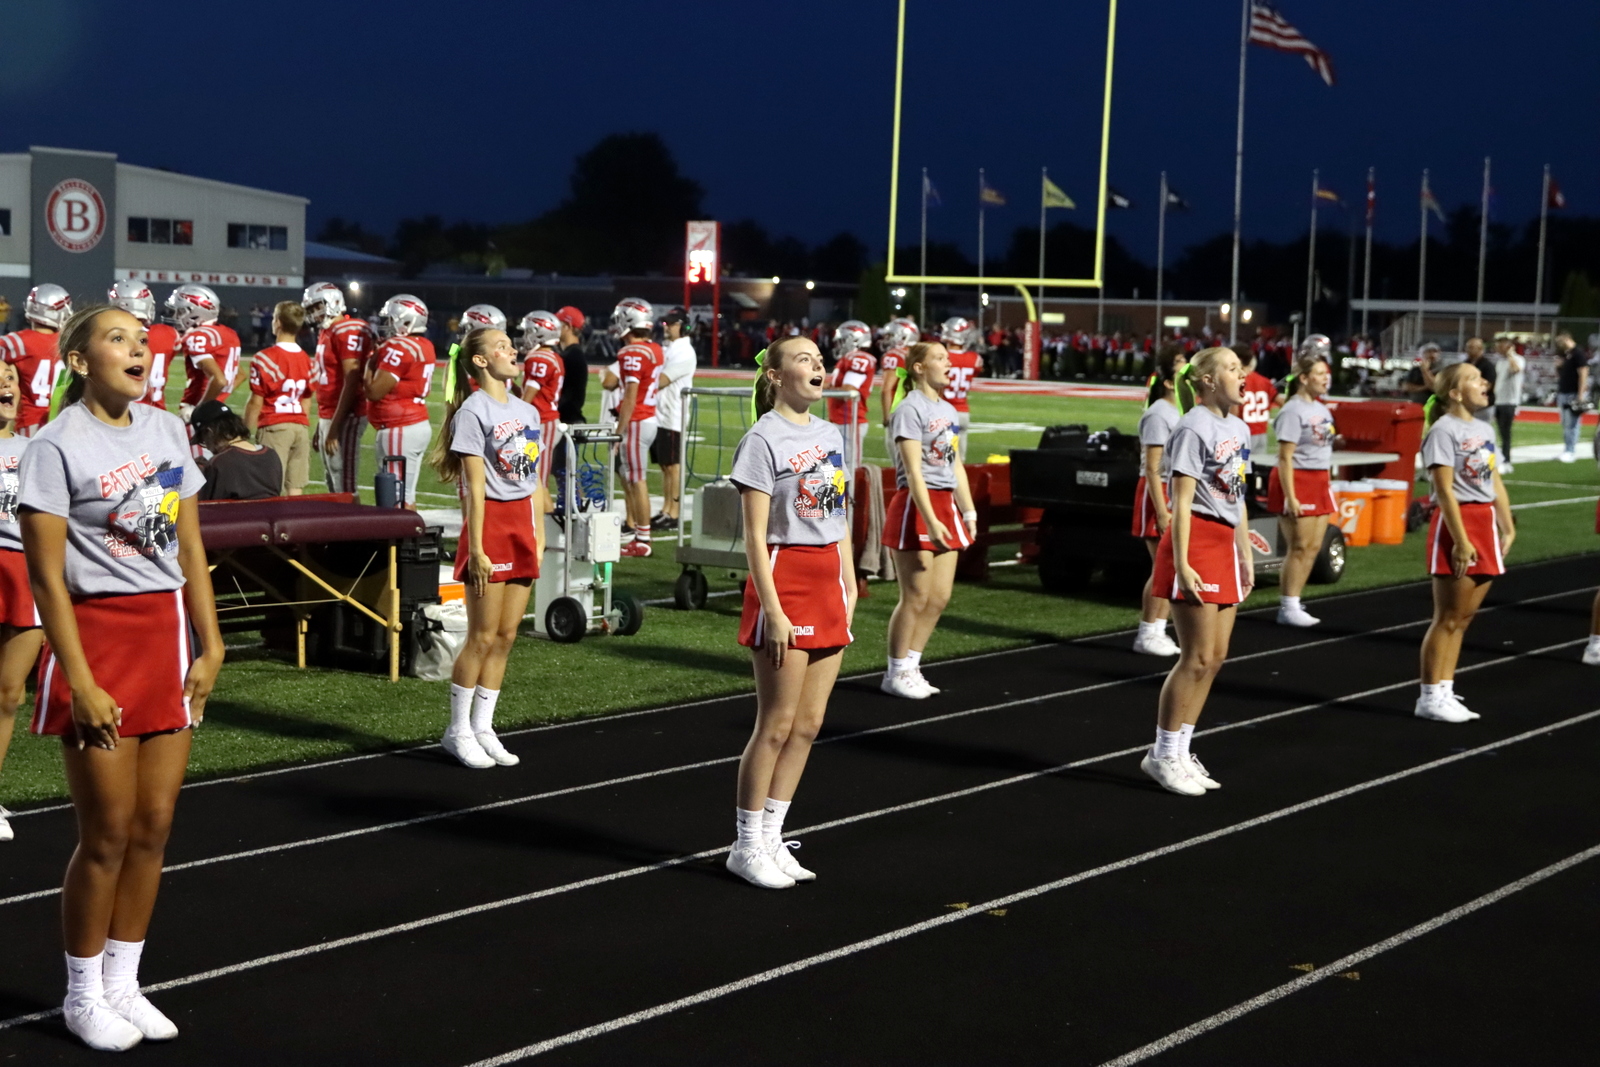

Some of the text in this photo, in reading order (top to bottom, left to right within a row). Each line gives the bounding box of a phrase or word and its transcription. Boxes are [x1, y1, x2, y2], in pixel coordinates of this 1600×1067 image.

[63, 199, 90, 232] B
[128, 271, 288, 286] FIELDHOUSE
[186, 336, 207, 353] 42
[347, 335, 364, 352] 51
[383, 347, 404, 367] 75
[623, 356, 643, 371] 25
[852, 357, 869, 372] 57
[531, 362, 548, 378] 13
[944, 366, 974, 399] 35
[274, 378, 306, 413] 21
[1243, 390, 1270, 423] 22
[788, 444, 828, 474] BATTLE
[98, 452, 158, 499] BATTLE
[146, 502, 161, 515] 20
[1340, 501, 1357, 518] G
